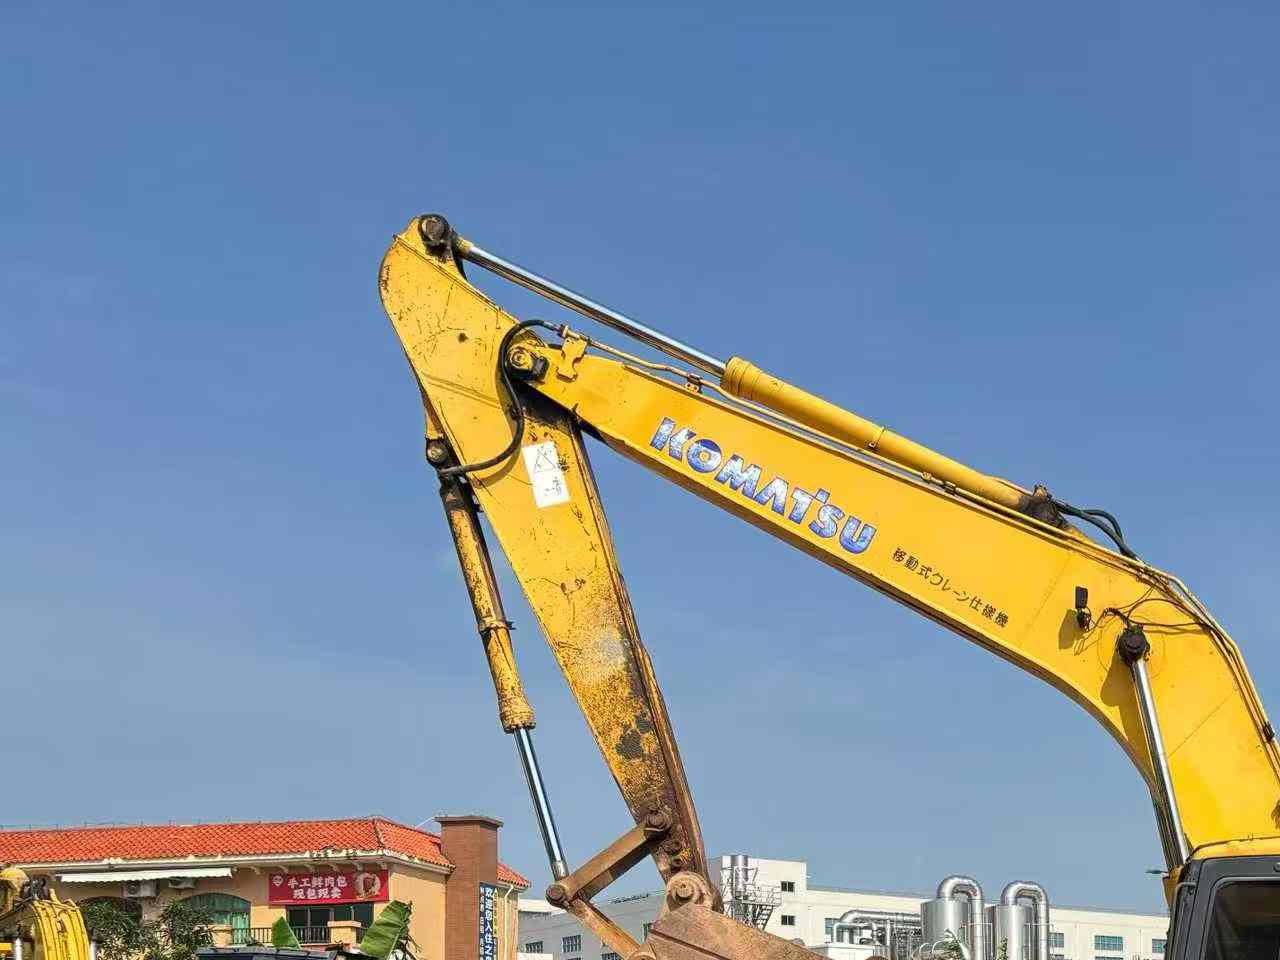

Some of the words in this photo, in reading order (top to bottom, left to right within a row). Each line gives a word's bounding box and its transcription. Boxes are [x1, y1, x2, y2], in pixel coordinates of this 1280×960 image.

[650, 417, 877, 554] KOMATSU
[892, 546, 1009, 627] 移動式クレーン仕様機
